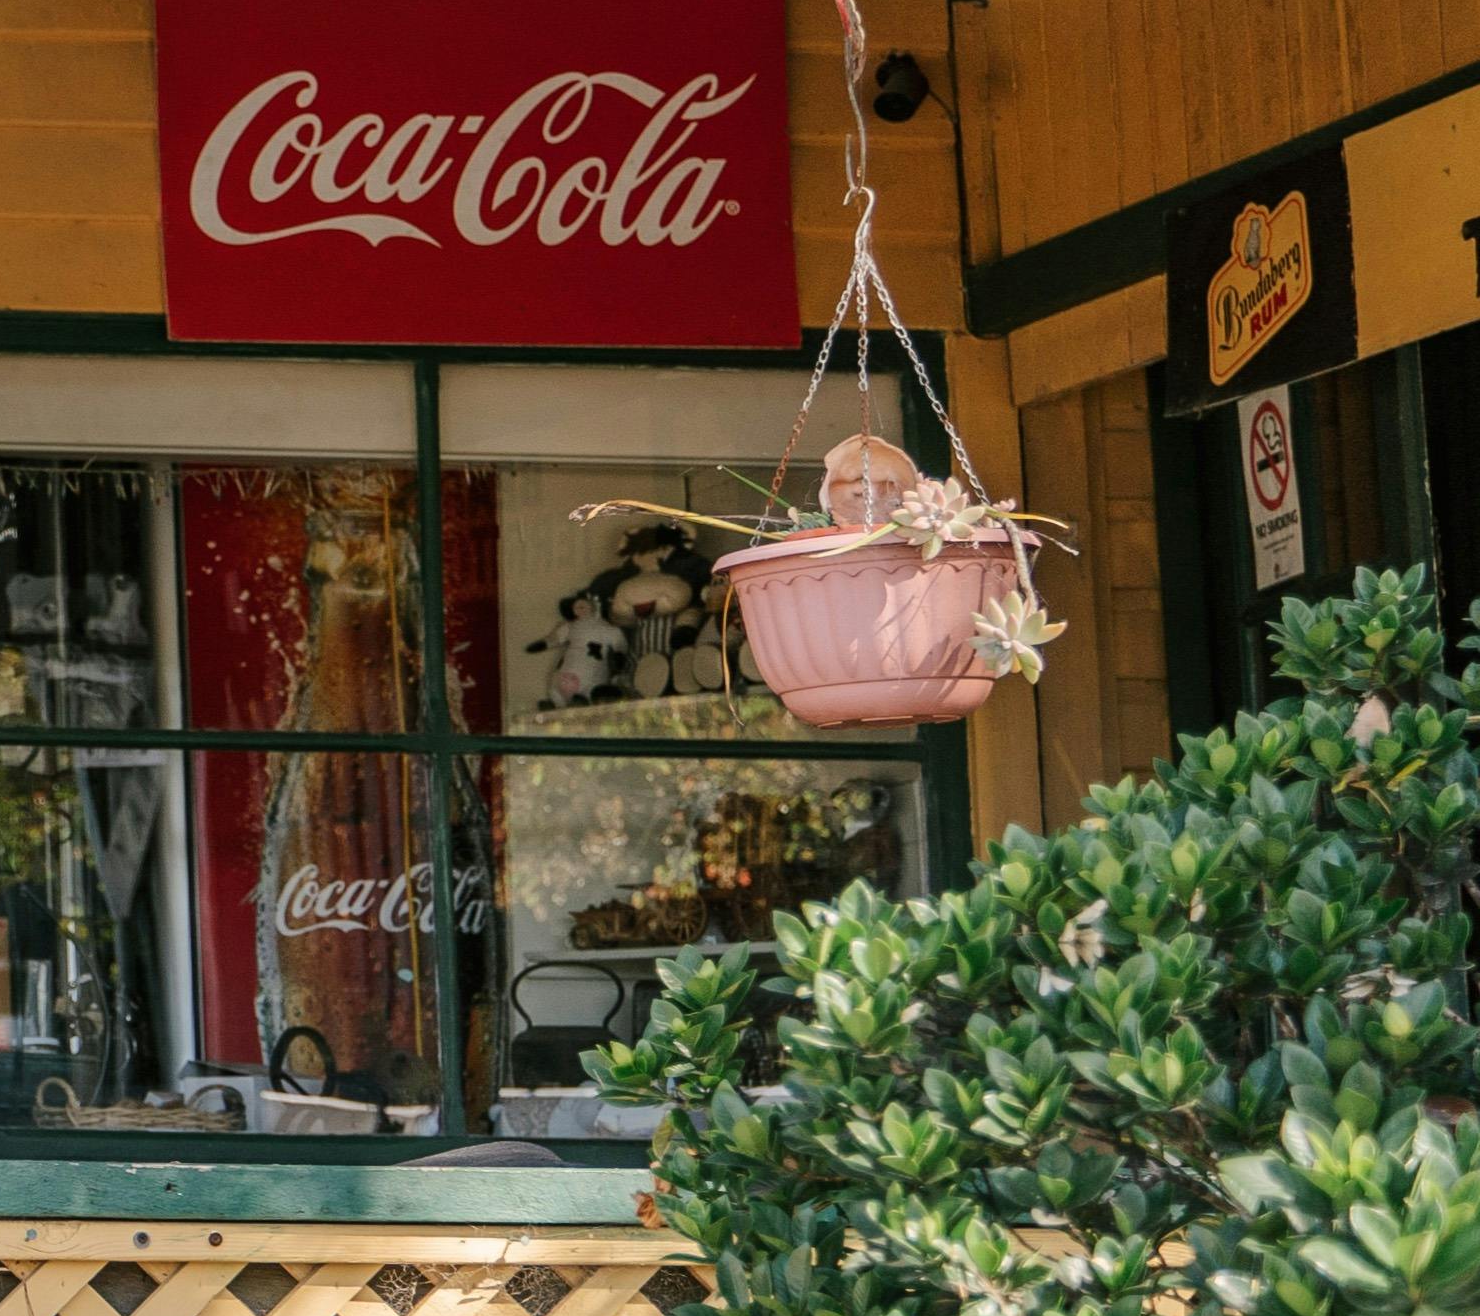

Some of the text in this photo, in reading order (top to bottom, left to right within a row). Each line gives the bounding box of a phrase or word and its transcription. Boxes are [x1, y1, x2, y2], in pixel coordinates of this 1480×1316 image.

[190, 70, 757, 247] Coca-Cola
[1216, 242, 1301, 351] Bundaberg
[1251, 282, 1288, 340] RUM
